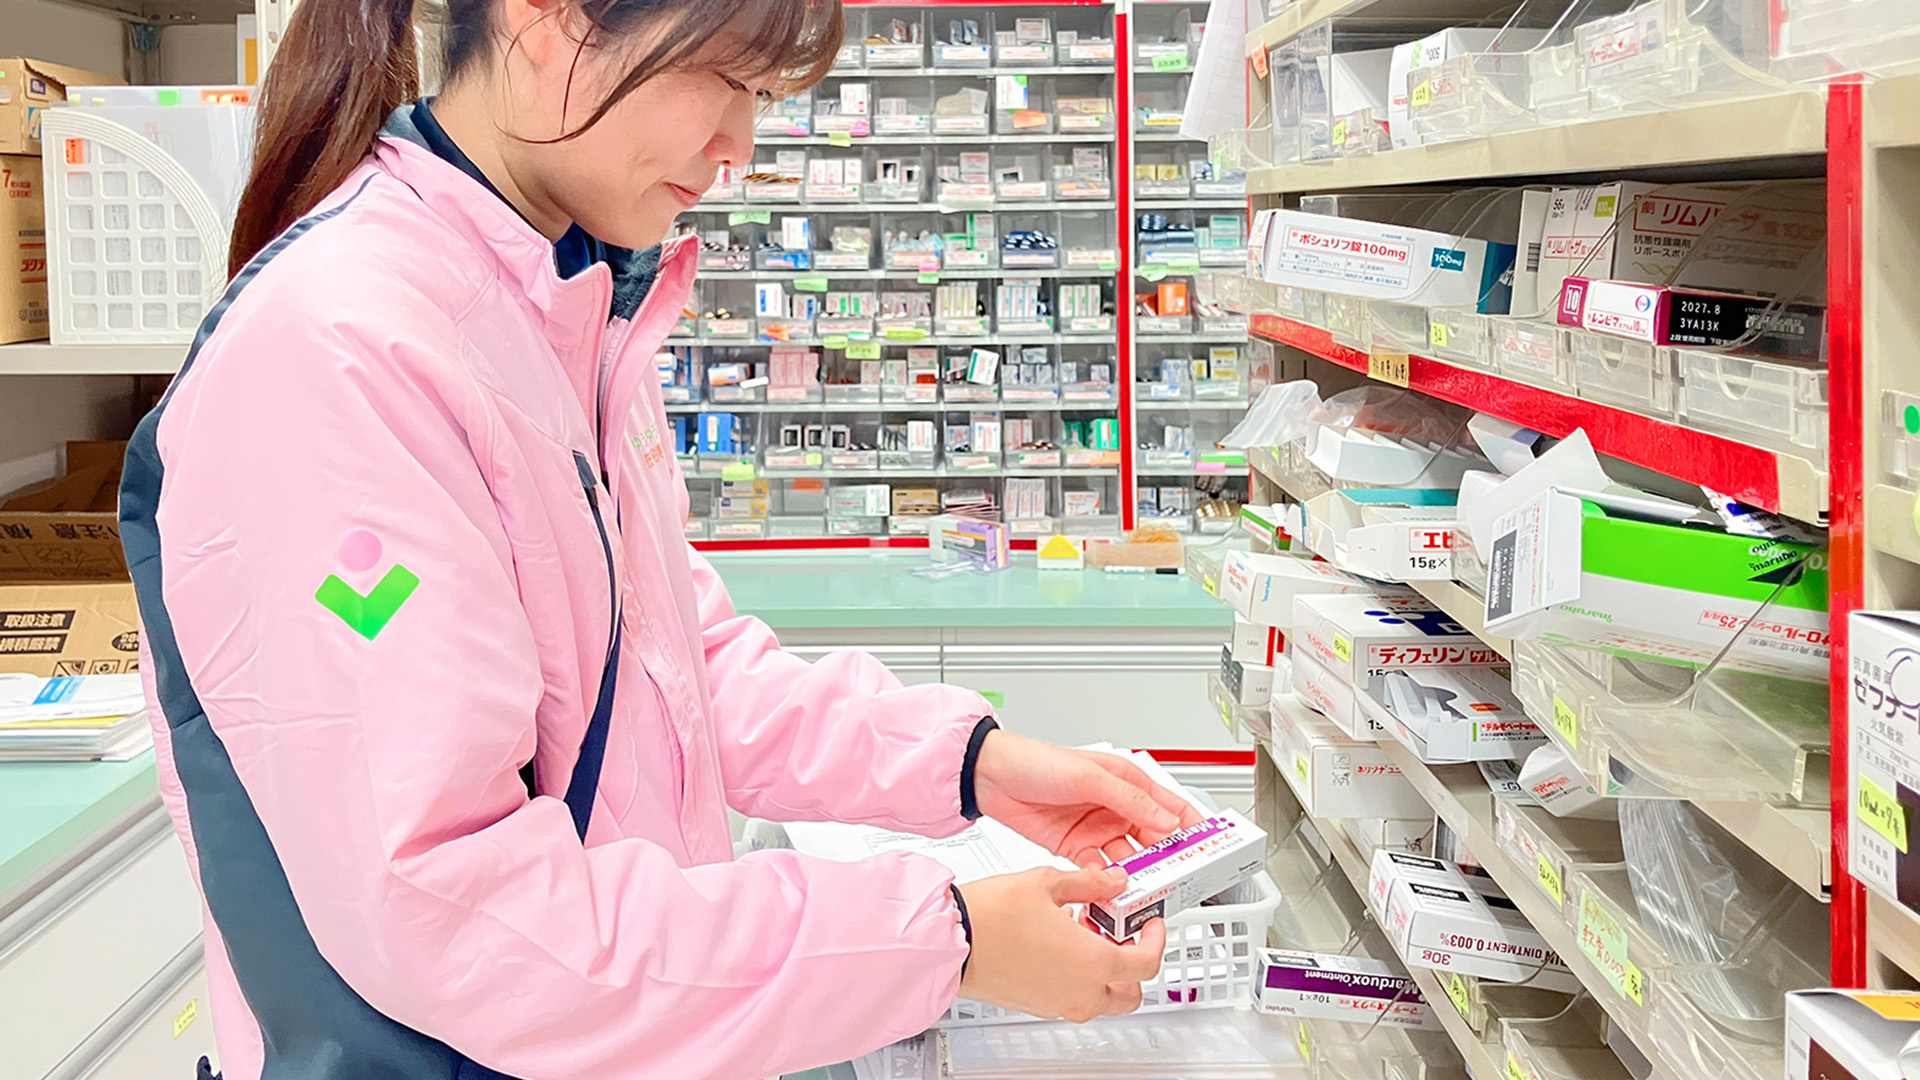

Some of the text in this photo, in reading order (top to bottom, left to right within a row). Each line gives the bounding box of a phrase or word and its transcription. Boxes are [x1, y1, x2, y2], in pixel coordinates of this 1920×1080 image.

[1299, 233, 1406, 261] ボシュリフ錠100mg
[1567, 289, 1579, 311] 10
[1680, 318, 1720, 331] 3YA13K
[4, 613, 66, 628] 取扱注意
[1559, 604, 1613, 623] maruho
[1379, 647, 1466, 664] ディフェリン
[1422, 950, 1451, 966] 30g
[1486, 941, 1542, 959] OINTMENT
[1305, 969, 1350, 984] Ointment
[1299, 993, 1330, 1003] 10g×1
